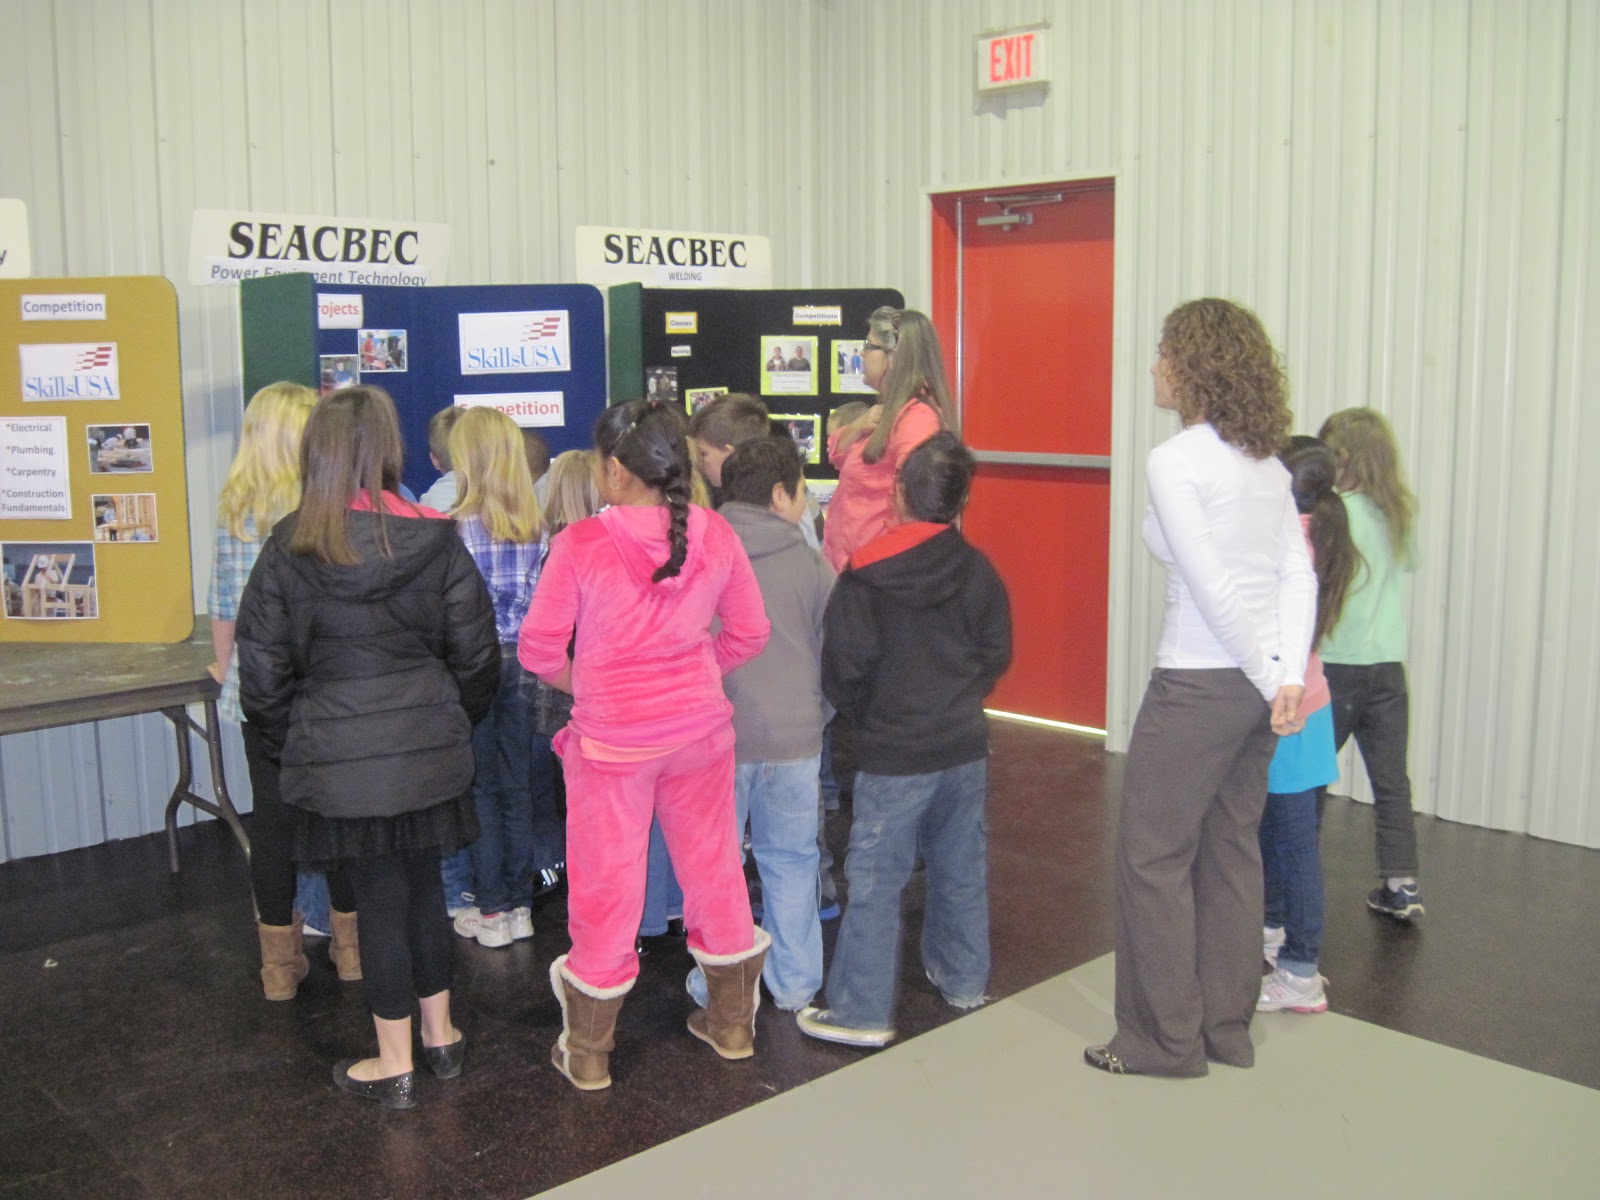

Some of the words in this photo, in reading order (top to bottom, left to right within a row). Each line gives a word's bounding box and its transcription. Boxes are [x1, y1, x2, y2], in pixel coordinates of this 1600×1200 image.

[990, 33, 1035, 82] EXIT
[227, 221, 419, 265] SEACBEC
[604, 233, 747, 268] SEACBEC
[211, 265, 259, 279] Power
[348, 270, 428, 287] Technology
[668, 271, 703, 281] WELDING
[23, 300, 103, 315] Competition
[467, 345, 561, 369] SkillsUSA
[25, 375, 114, 399] SkillsUSA
[459, 401, 560, 416] petition
[1, 503, 65, 512] Fundamentals
